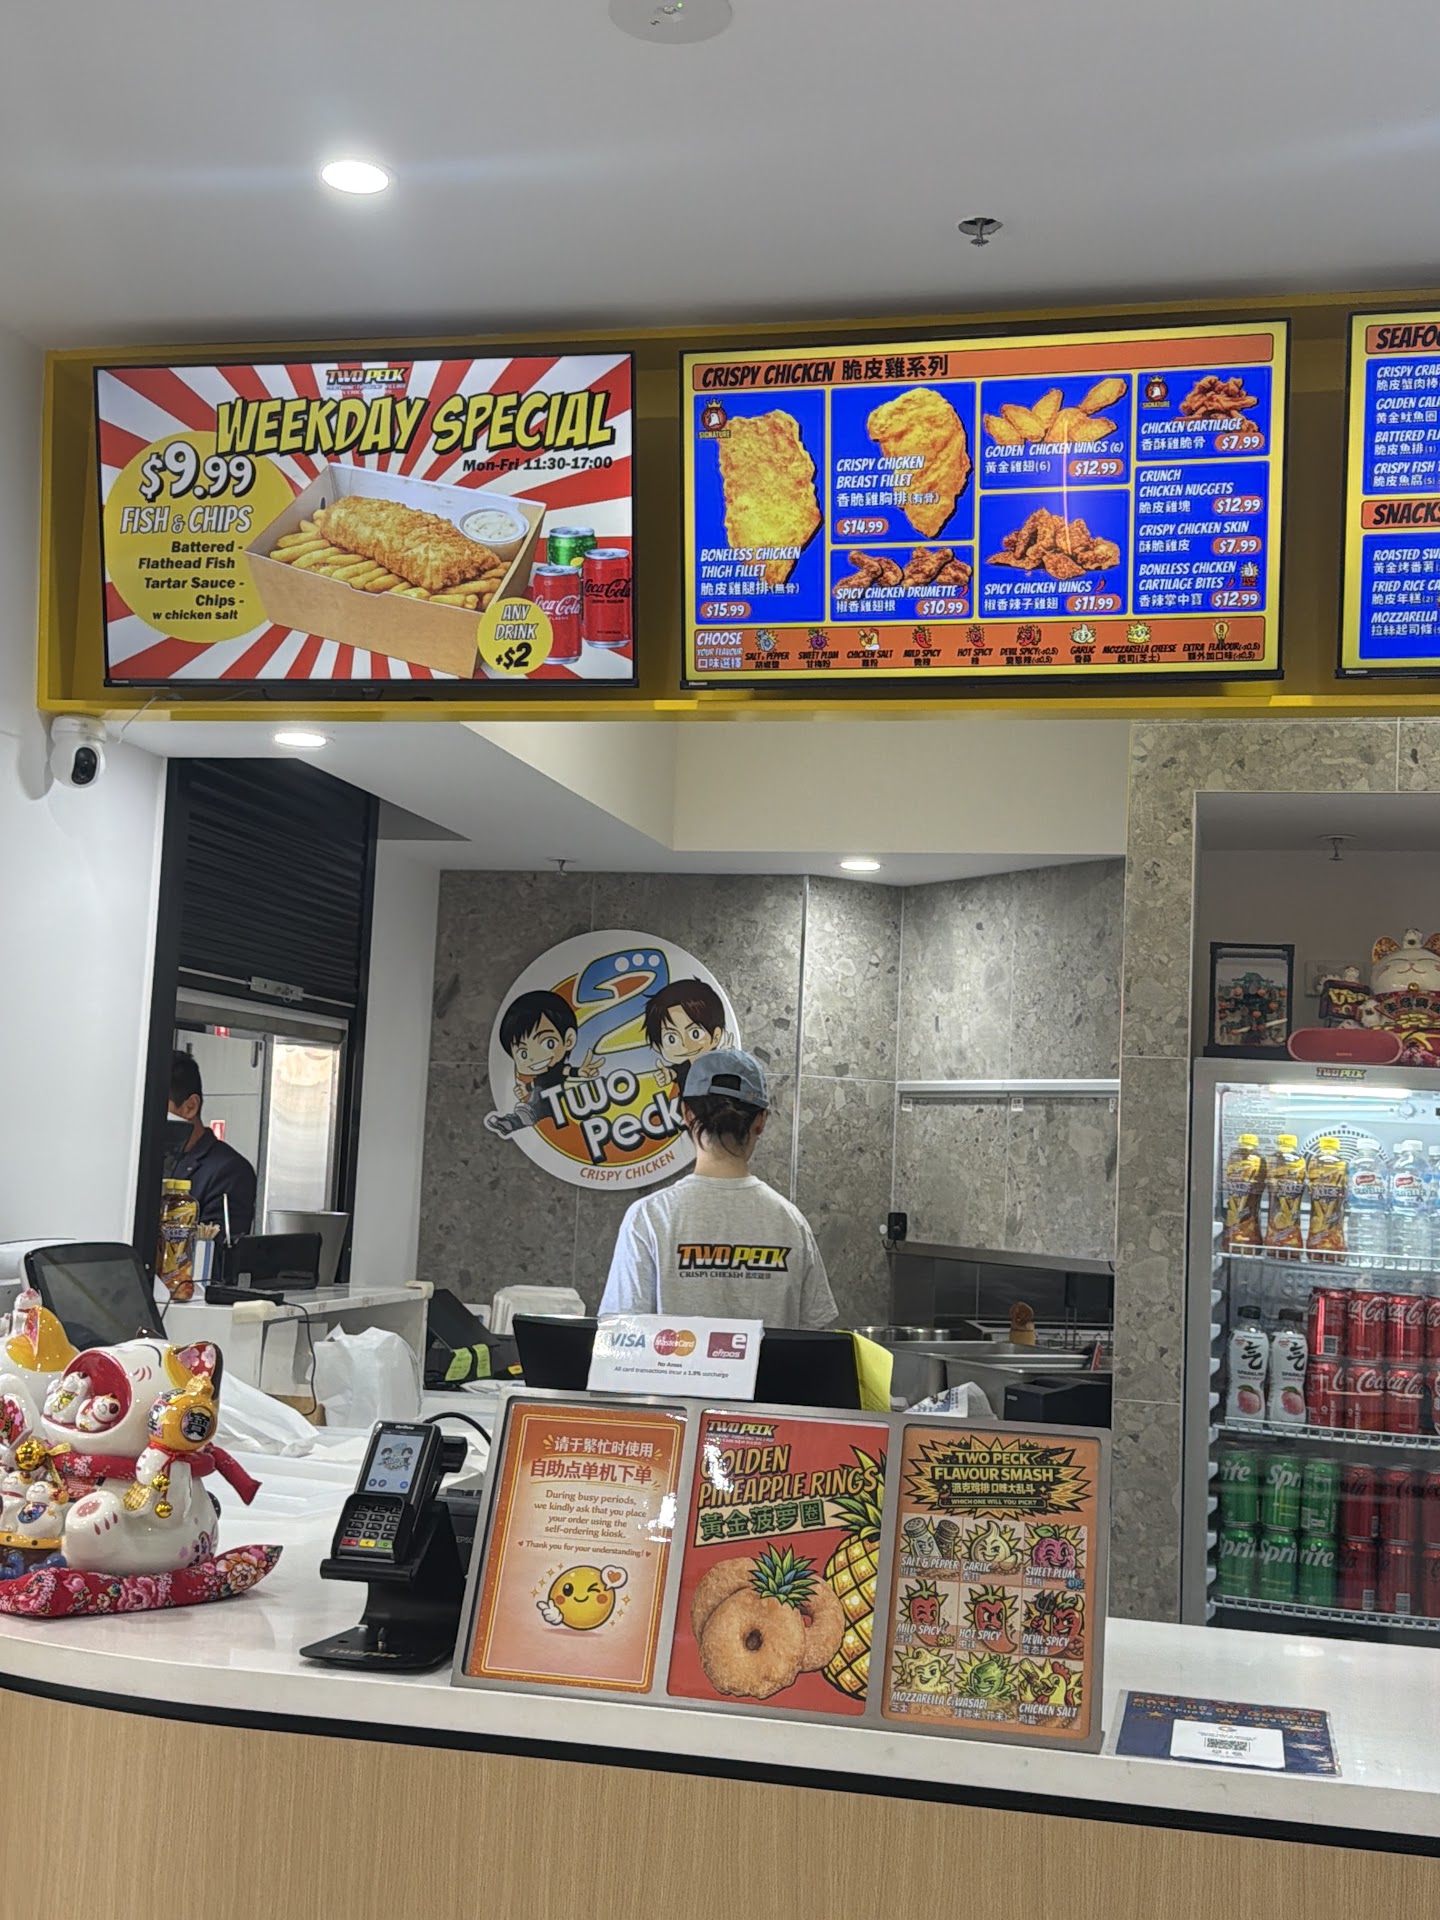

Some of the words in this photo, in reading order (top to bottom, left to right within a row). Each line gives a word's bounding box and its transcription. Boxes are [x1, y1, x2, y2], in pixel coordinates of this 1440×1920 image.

[1376, 326, 1440, 349] SEAFO
[326, 368, 365, 385] TWO
[364, 367, 409, 384] PECK
[702, 364, 760, 388] CRISPY
[763, 361, 836, 385] CHICKEN
[841, 354, 949, 381] 脆皮雞系列
[1377, 365, 1413, 378] CRISPY
[1376, 398, 1417, 411] GOLDEN
[216, 395, 430, 460] WEEKDAY
[431, 389, 616, 455] SPECIAL
[1140, 420, 1185, 435] CHICKEN
[1185, 418, 1243, 433] CARTILAGE
[698, 430, 731, 439] SIGNATURE
[1374, 430, 1425, 443] BATTERED
[985, 443, 1025, 458] GOLDEN
[1028, 441, 1073, 457] CHICKEN
[1073, 441, 1109, 455] WINGS
[1221, 435, 1260, 450] $7.99
[463, 458, 518, 471] Mon-Fri
[523, 456, 613, 470] 11:30-17:00
[836, 458, 876, 472] CRISPY
[877, 455, 925, 470] CHICKEN
[1074, 460, 1118, 475] $12.99
[1373, 462, 1410, 475] CRISPY
[1412, 461, 1435, 473] FISH
[139, 440, 256, 503] $9.99
[1140, 468, 1182, 483] CRUNCH
[836, 474, 879, 490] BREAST
[879, 473, 914, 488] FILLET
[1139, 483, 1185, 498] CHICKEN
[1185, 481, 1234, 496] NUGGETS
[1216, 498, 1261, 513] $12.99
[120, 505, 170, 534] FISH
[171, 515, 186, 534] &
[188, 505, 254, 533] CHIPS
[842, 519, 884, 535] $14.99
[1139, 522, 1176, 537] CRISPY
[1177, 521, 1222, 535] CHICKEN
[1223, 520, 1250, 534] SKIN
[171, 541, 235, 553] Battered
[1218, 539, 1257, 553] $7.99
[700, 547, 753, 562] BONELESS
[755, 546, 801, 561] CHICKEN
[1373, 549, 1420, 562] ROASTED
[138, 557, 201, 569] Flathead
[205, 557, 235, 569] Fish
[1139, 562, 1191, 576] BONELESS
[1191, 560, 1237, 575] CHICKEN
[701, 564, 734, 579] THIGH
[734, 563, 766, 578] FILLET
[144, 577, 188, 588] Tartar
[190, 577, 235, 588] Sauce
[984, 582, 1013, 596] SPICY
[1013, 581, 1057, 595] CHICKEN
[1057, 580, 1092, 593] WINGS
[1138, 577, 1194, 591] CARTILAGE
[1195, 576, 1224, 589] BITES
[1372, 580, 1400, 593] FRIED
[1403, 579, 1426, 591] RICE
[836, 586, 864, 600] SPICY
[864, 586, 906, 599] CHICKEN
[907, 585, 957, 598] DRUMETTE
[1214, 592, 1258, 607] $12.99
[195, 595, 235, 608] Chips
[922, 600, 963, 615] $10.99
[1073, 596, 1114, 611] $11.99
[165, 610, 212, 620] chicken
[215, 610, 238, 619] salt
[502, 604, 531, 621] ANY
[706, 602, 745, 618] $15.99
[1371, 611, 1438, 623] MOZZARELLA
[495, 623, 539, 641] DRINK
[697, 632, 743, 646] CHOOSE
[495, 642, 532, 670] +$2
[540, 1069, 640, 1130] Two
[580, 1091, 689, 1166] Peck
[579, 1166, 622, 1181] CRISPY
[625, 1150, 676, 1181] CHICKEN
[677, 1244, 733, 1270] TWO
[731, 1245, 792, 1272] PECK
[710, 1271, 743, 1279] CHICKEN
[611, 1332, 646, 1348] VISA
[655, 1338, 695, 1349] MasterCard
[712, 1348, 741, 1359] eftpos
[635, 1367, 667, 1375] transactions
[706, 1420, 740, 1435] TWO
[739, 1423, 779, 1438] PECK
[554, 1436, 654, 1458] 请于繁忙时使用
[957, 1452, 990, 1465] TWO
[992, 1453, 1030, 1466] PECK
[530, 1458, 652, 1485] 自助点单机下单
[934, 1467, 999, 1481] FLAVOUR
[1001, 1468, 1054, 1482] SMASH
[698, 1471, 806, 1510] PINEAPPLE
[810, 1466, 879, 1498] RINGS
[546, 1490, 576, 1502] During
[578, 1492, 599, 1505] busy
[601, 1494, 636, 1506] periods,
[549, 1501, 574, 1513] kindly
[576, 1505, 590, 1513] ask
[591, 1506, 608, 1515] that
[610, 1509, 624, 1517] you
[626, 1509, 646, 1519] place
[548, 1515, 566, 1523] your
[568, 1515, 589, 1525] order
[591, 1518, 612, 1528] using
[614, 1520, 627, 1528] the
[545, 1525, 599, 1537] self-ordering
[601, 1529, 626, 1539] kiosk.
[526, 1540, 548, 1549] Thank
[549, 1544, 562, 1552] you
[563, 1543, 574, 1551] for
[575, 1545, 591, 1553] your
[592, 1545, 644, 1558] understanding!
[901, 1557, 921, 1567] SALT
[929, 1559, 959, 1570] PEPPER
[963, 1561, 993, 1573] GARLIC
[1025, 1566, 1050, 1577] SWEET
[1052, 1568, 1075, 1579] PLUM
[896, 1623, 917, 1634] MILD
[918, 1625, 942, 1636] SPICY
[959, 1628, 975, 1639] HOT
[977, 1630, 1001, 1641] SPICY
[1023, 1634, 1043, 1645] DEVIL
[1045, 1636, 1069, 1647] SPICY
[892, 1691, 946, 1706] MOZZARELLA
[955, 1697, 987, 1709] WASABI
[1019, 1703, 1054, 1716] CHICKEN
[1056, 1706, 1078, 1718] SALT
